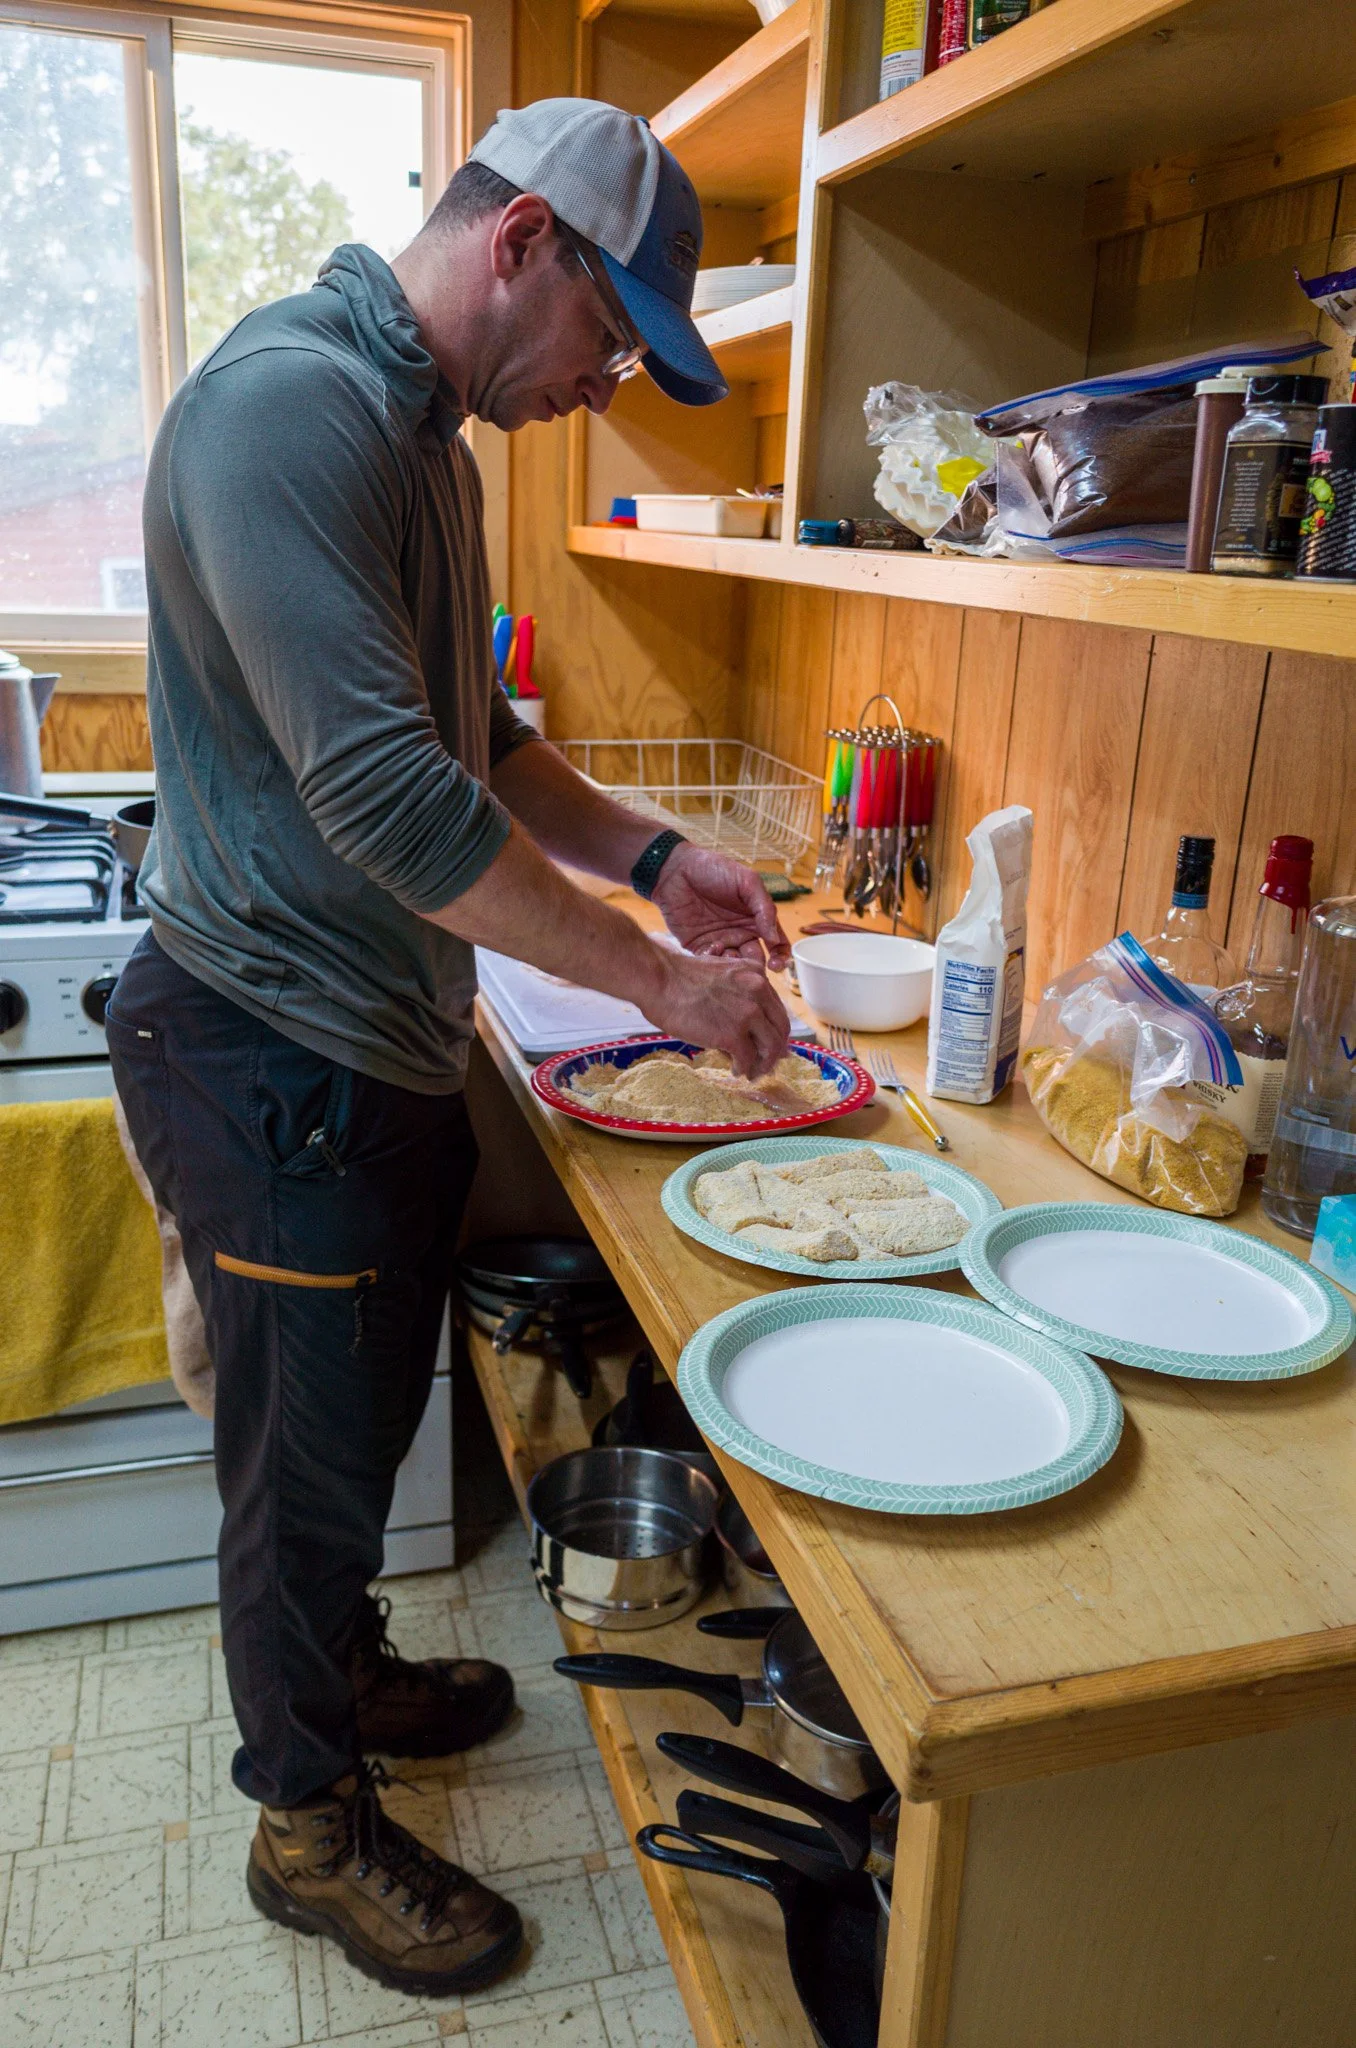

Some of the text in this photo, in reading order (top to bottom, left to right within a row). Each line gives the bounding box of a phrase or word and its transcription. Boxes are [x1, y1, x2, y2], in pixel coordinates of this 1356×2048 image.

[948, 961, 994, 974] Nutrition Facts
[944, 982, 993, 993] Calories 110
[1192, 1080, 1227, 1103] WHISKY
